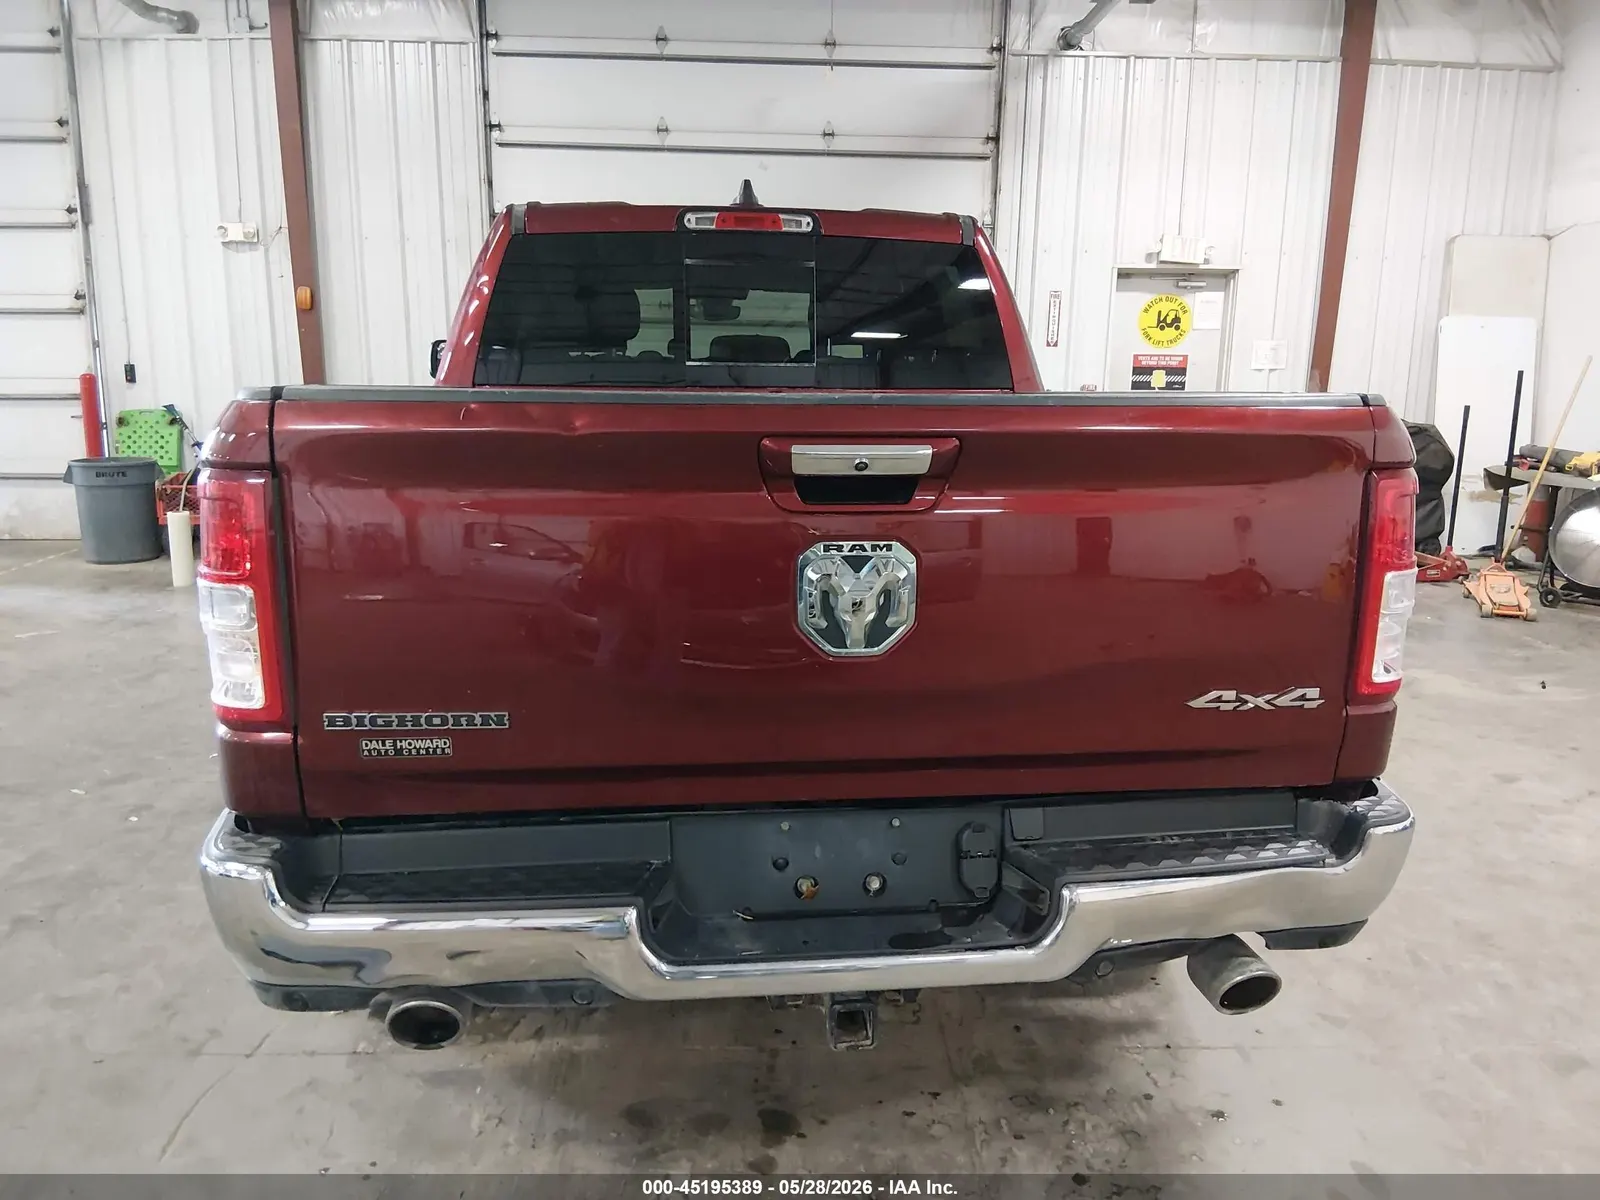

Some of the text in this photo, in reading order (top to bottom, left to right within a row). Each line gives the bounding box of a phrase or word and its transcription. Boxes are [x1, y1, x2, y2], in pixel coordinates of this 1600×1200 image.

[1142, 296, 1188, 315] WATCH OUT FOR
[1141, 327, 1186, 347] FORK LIFT TRUCKS
[822, 543, 893, 553] RAM
[323, 711, 509, 730] BIGHORN
[361, 738, 450, 750] DALE HOWARD
